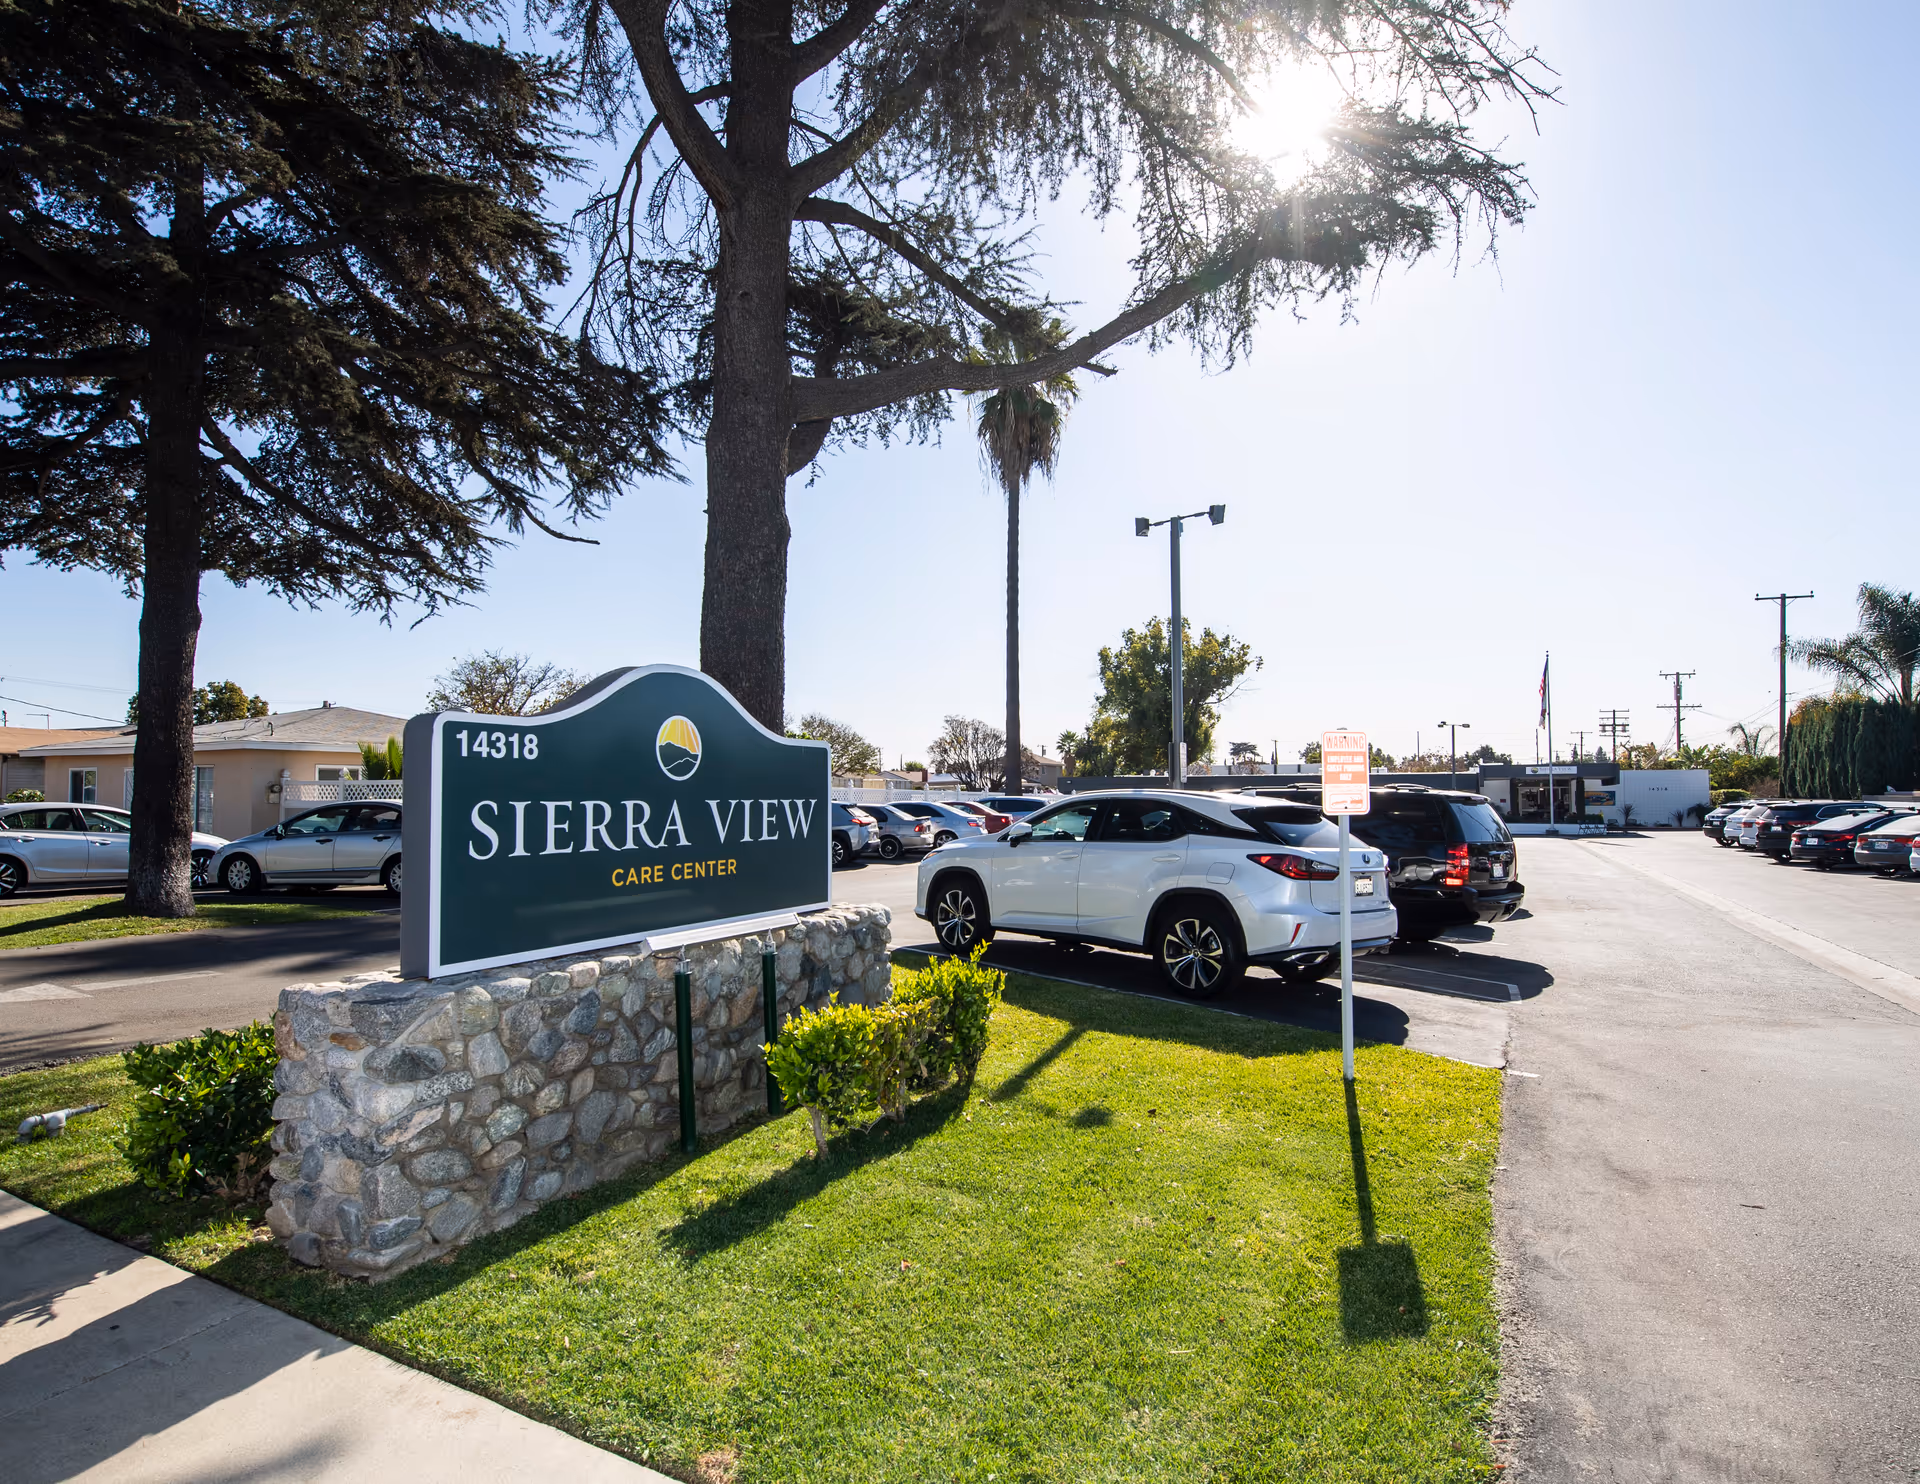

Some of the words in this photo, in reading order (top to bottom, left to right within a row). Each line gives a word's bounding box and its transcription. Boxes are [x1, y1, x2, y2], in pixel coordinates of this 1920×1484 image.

[456, 730, 538, 760] 14318
[1326, 735, 1364, 749] WARNING
[468, 800, 692, 861] SIERRA
[705, 799, 817, 844] VIEW
[612, 865, 664, 887] CARE
[671, 859, 737, 881] CENTER
